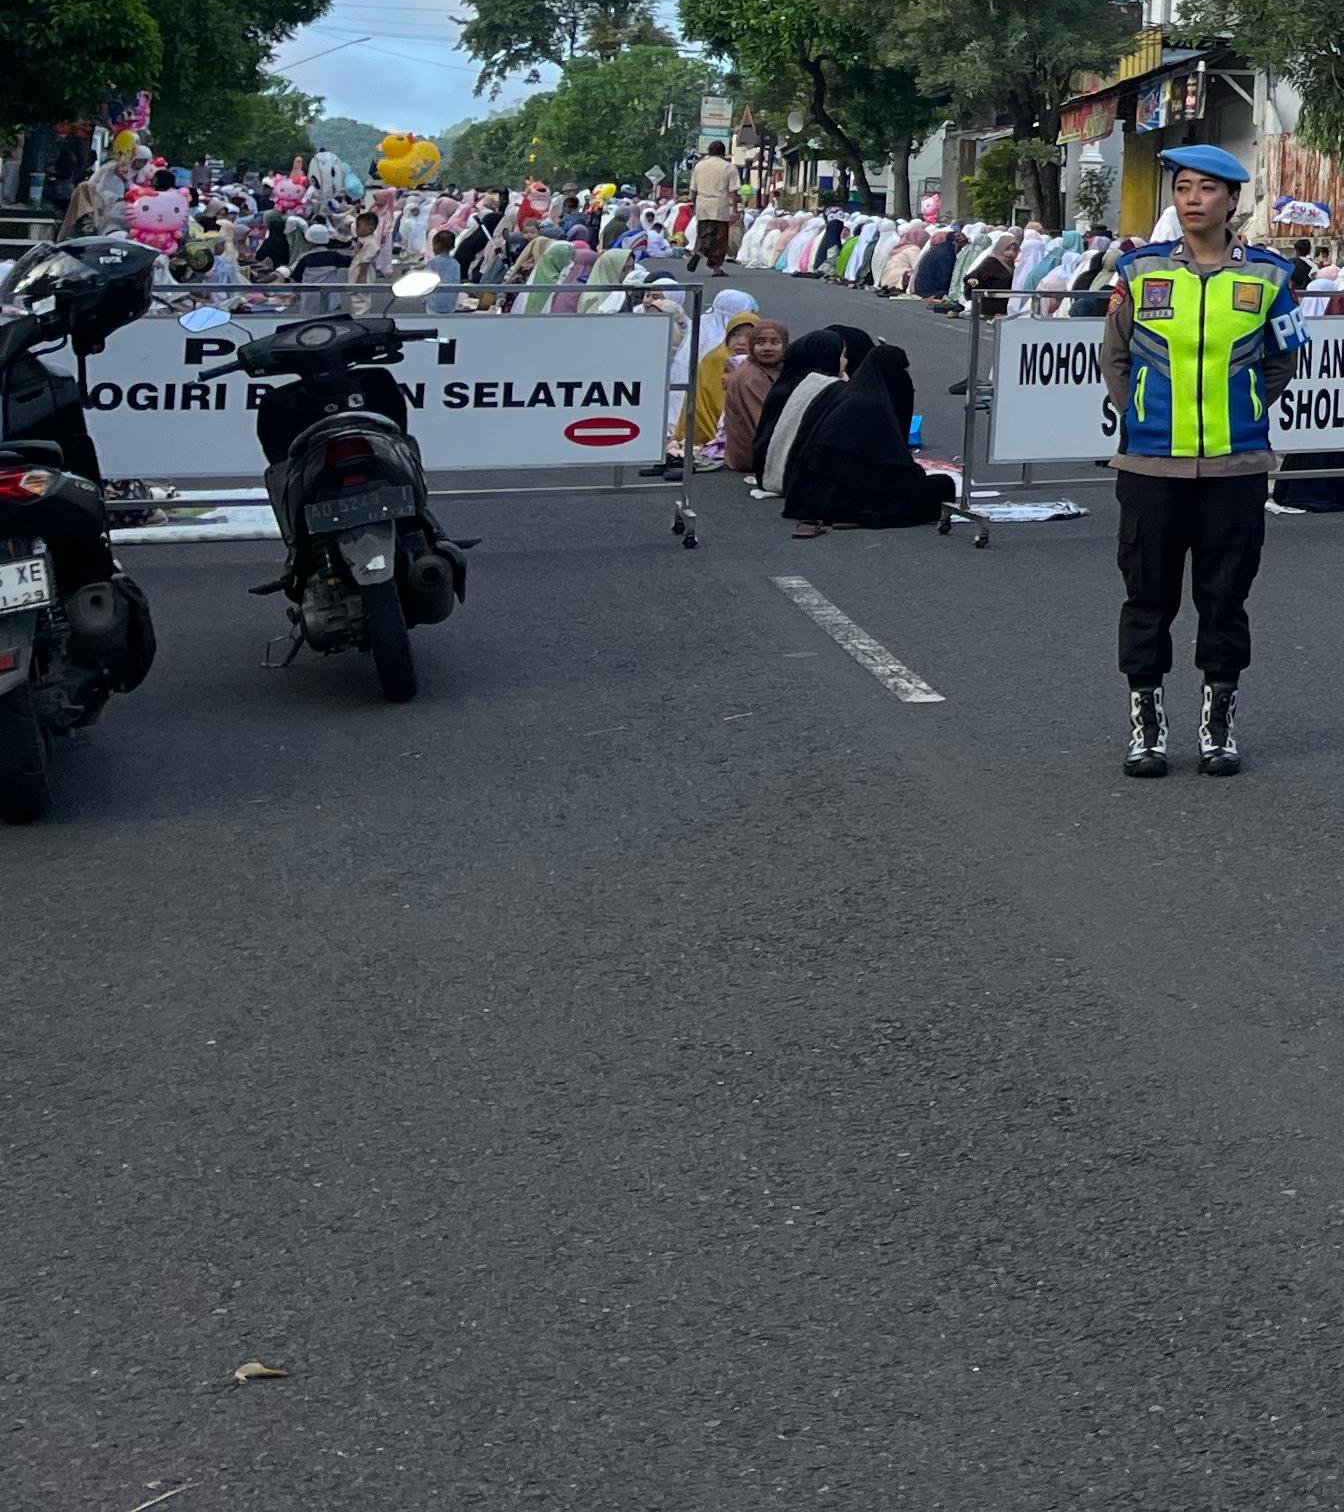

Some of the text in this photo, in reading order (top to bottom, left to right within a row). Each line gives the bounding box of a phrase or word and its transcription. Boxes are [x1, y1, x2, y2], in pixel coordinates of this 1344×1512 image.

[1018, 342, 1102, 386] MOHON
[442, 380, 642, 409] SELATAN
[15, 562, 42, 585] XE
